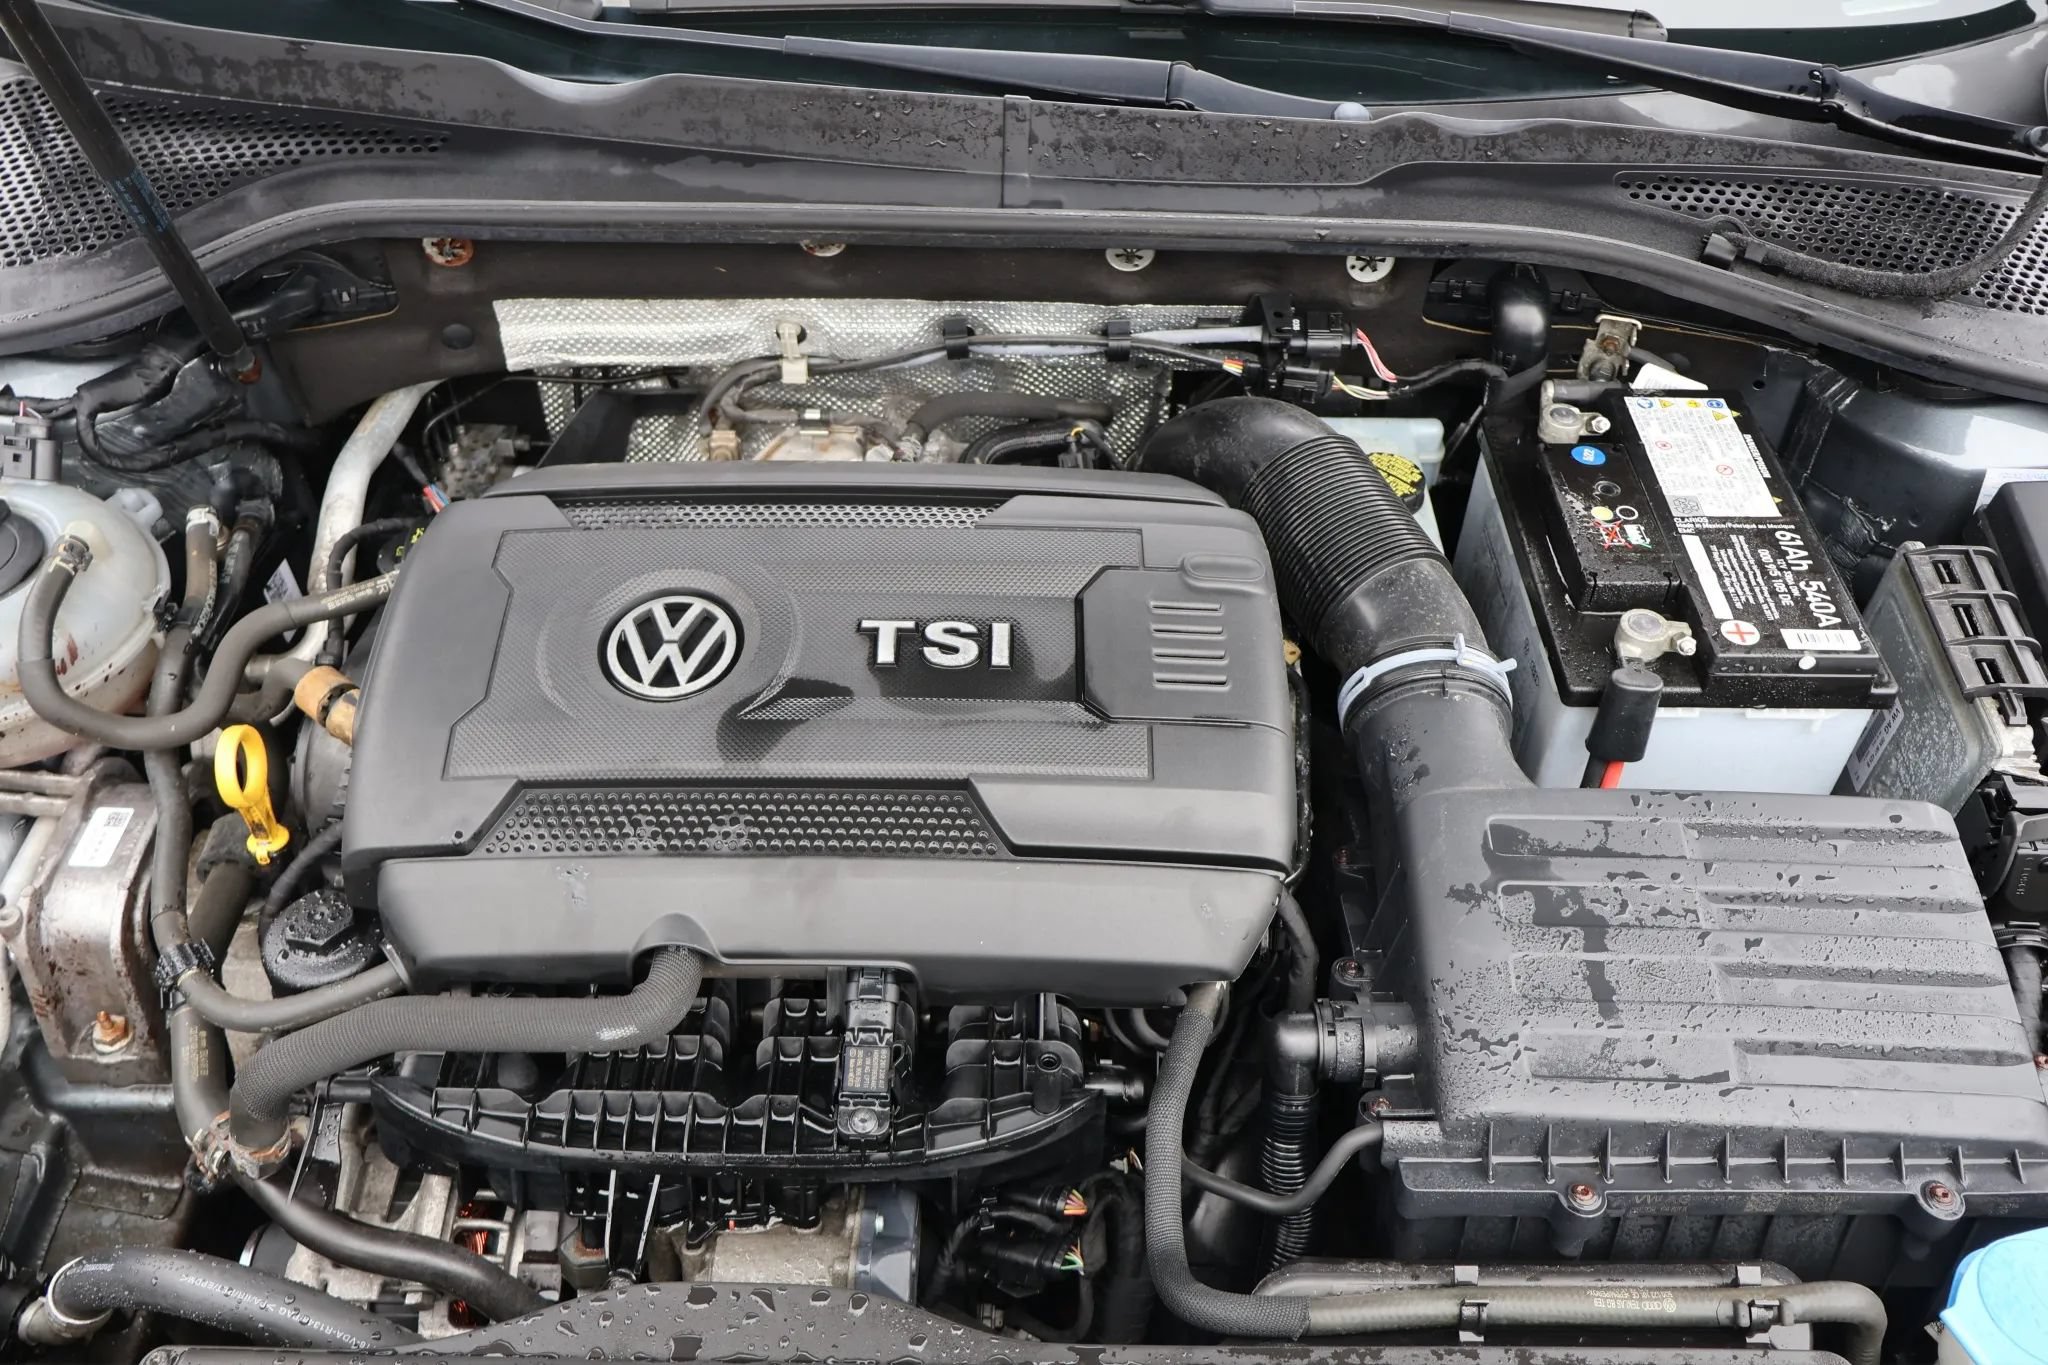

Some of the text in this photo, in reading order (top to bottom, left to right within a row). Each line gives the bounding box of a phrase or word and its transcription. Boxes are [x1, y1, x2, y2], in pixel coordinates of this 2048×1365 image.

[1775, 530, 1842, 628] 61Ah 540A
[1778, 593, 1794, 606] DE
[857, 619, 1013, 671] TSI
